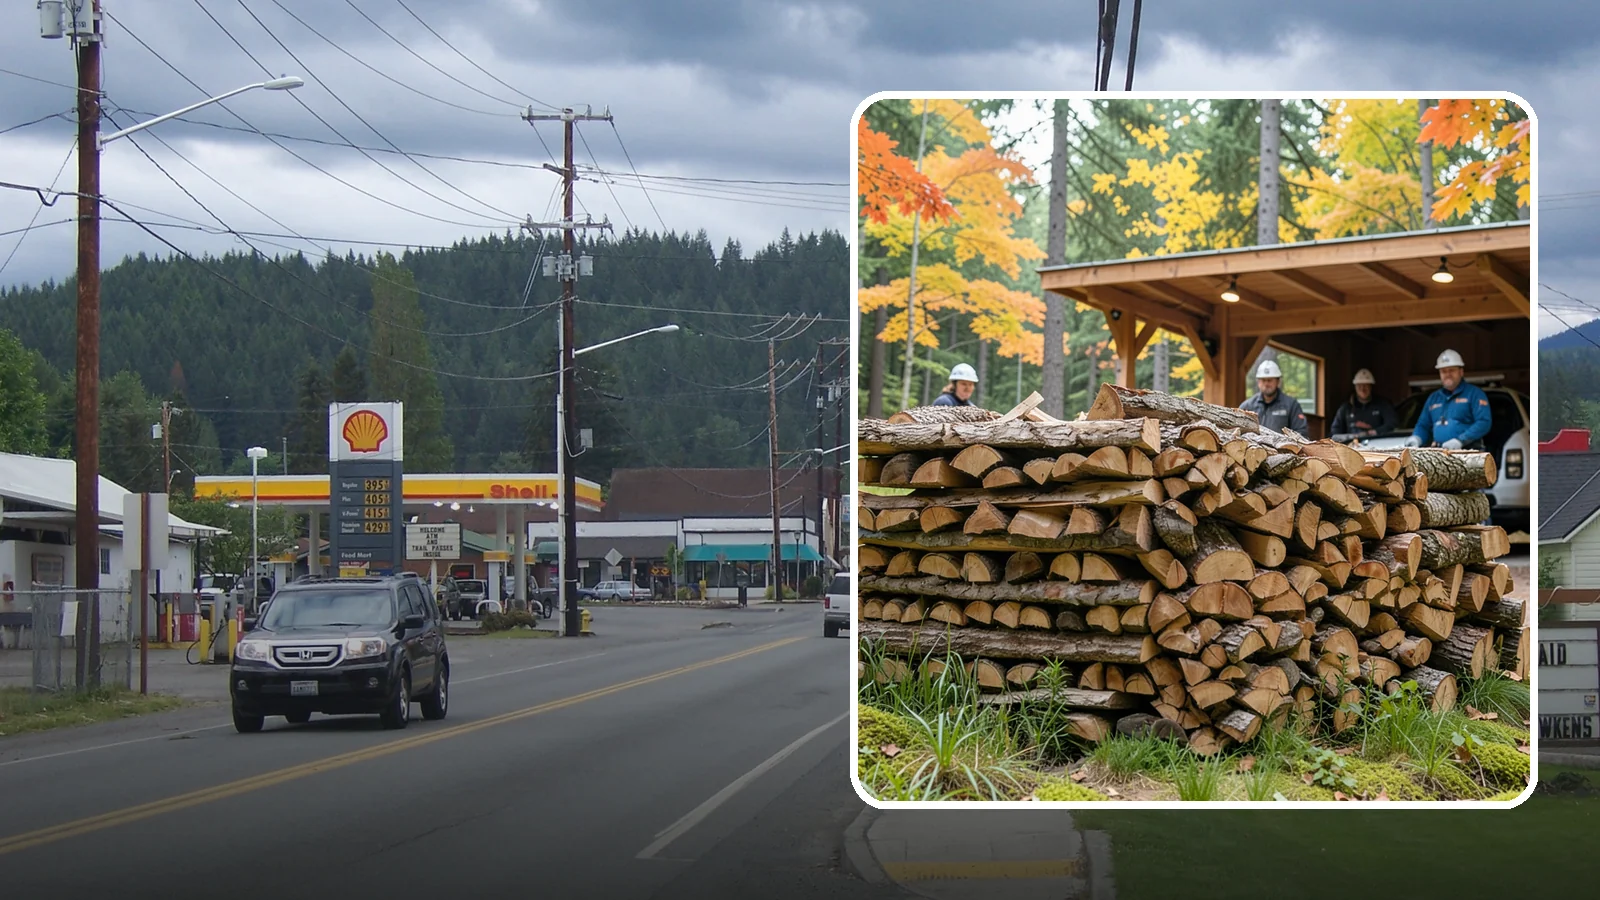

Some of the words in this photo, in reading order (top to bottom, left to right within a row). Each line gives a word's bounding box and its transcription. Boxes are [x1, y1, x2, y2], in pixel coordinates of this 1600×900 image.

[366, 480, 383, 490] 395
[490, 484, 547, 499] Shell
[366, 494, 383, 504] 405
[366, 508, 383, 518] 415
[366, 522, 383, 532] 429
